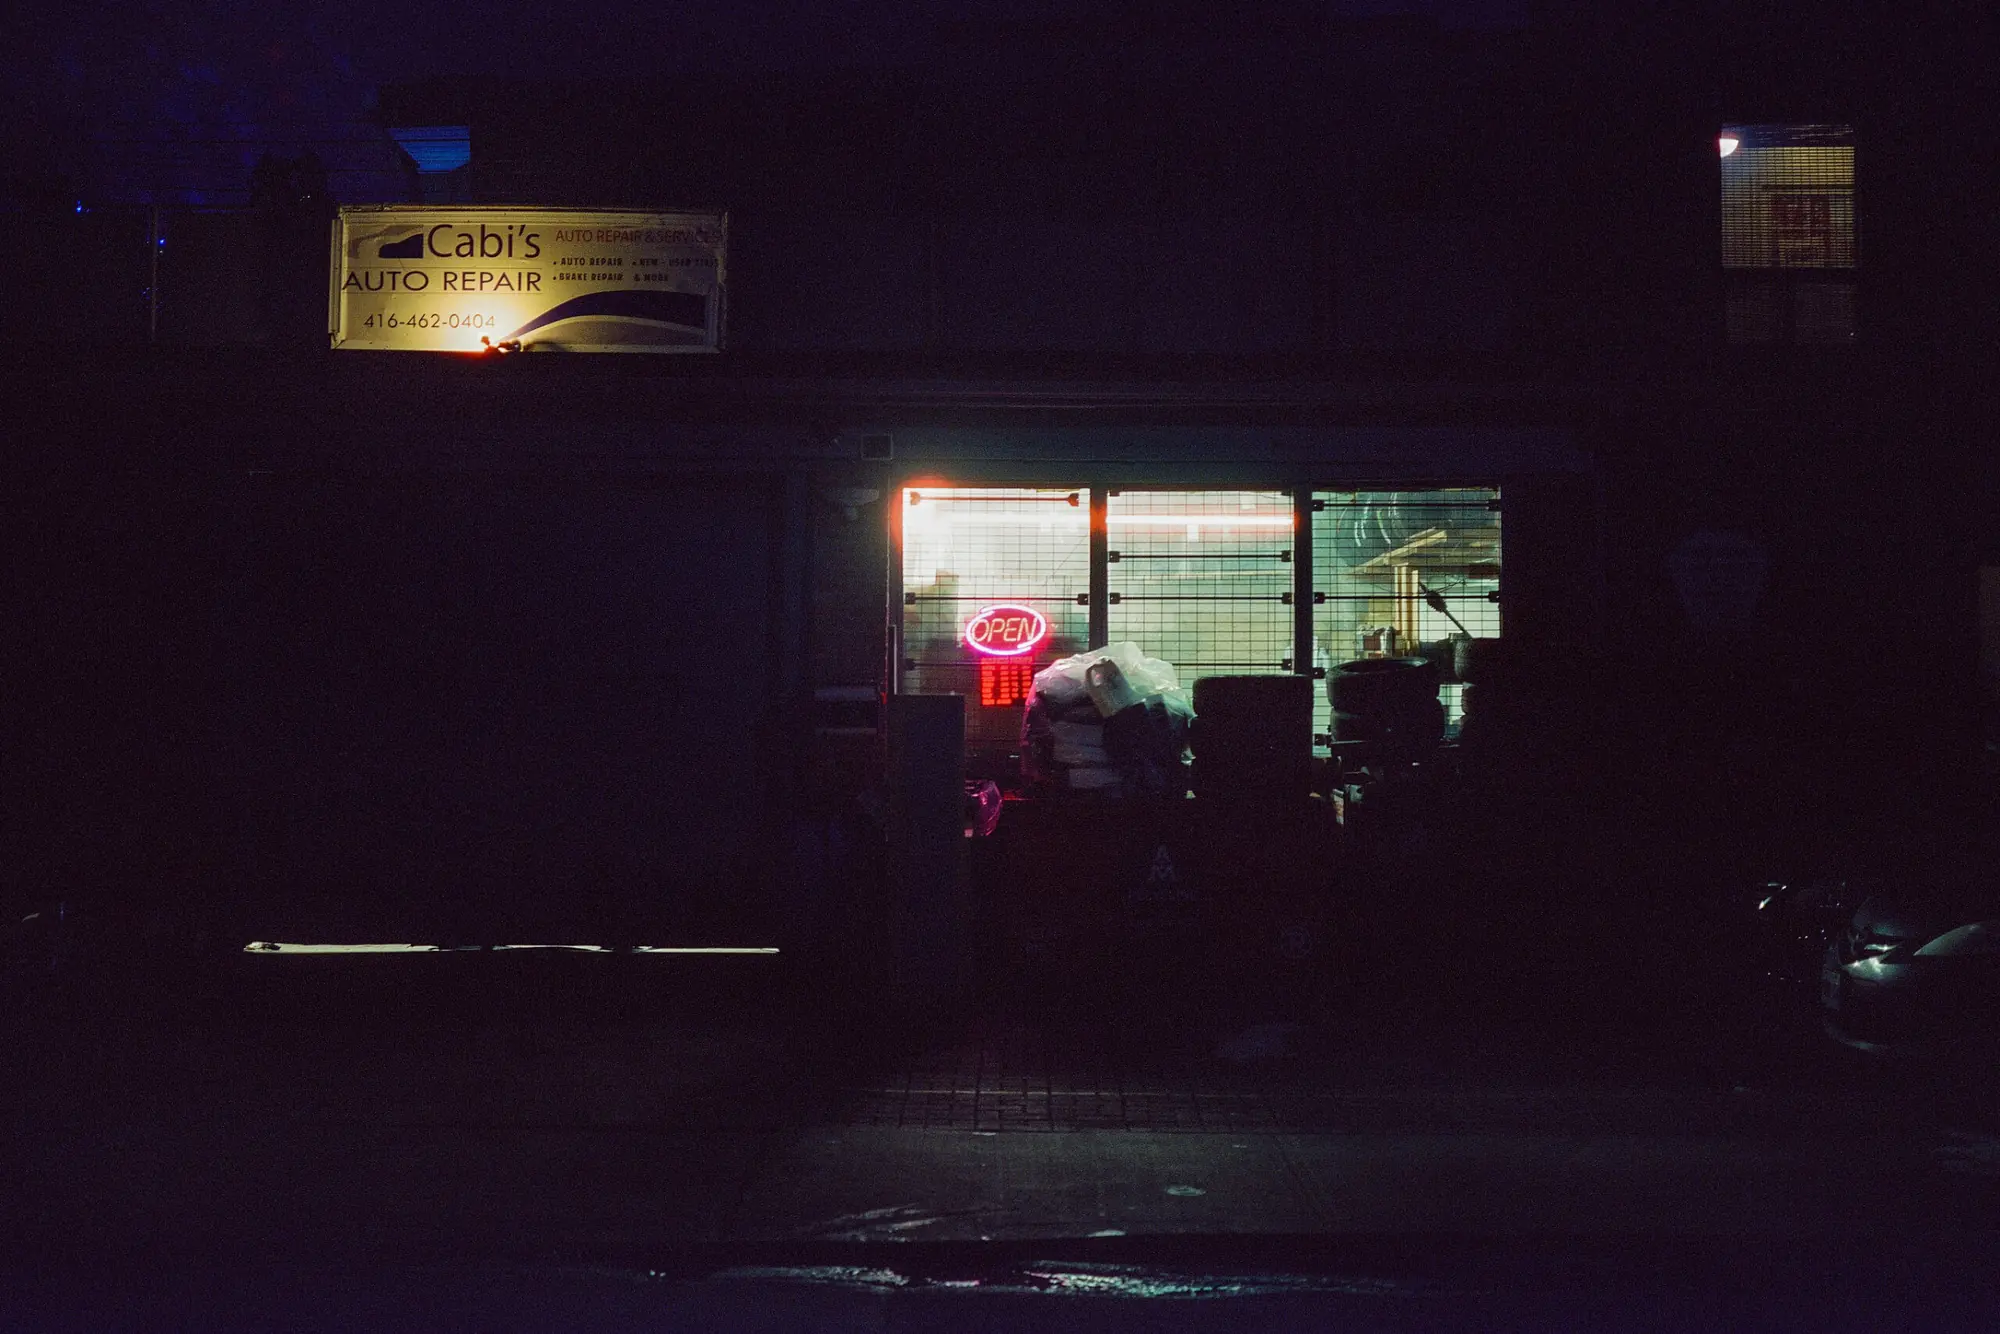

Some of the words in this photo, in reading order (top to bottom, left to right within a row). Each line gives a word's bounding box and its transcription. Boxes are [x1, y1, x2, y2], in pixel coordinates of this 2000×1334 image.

[427, 223, 541, 259] Cabi's
[555, 229, 593, 243] AUTO
[596, 229, 642, 244] REPAIR
[561, 257, 586, 266] AUTO
[589, 257, 623, 266] REPAIR
[342, 270, 429, 291] AUTO
[443, 271, 541, 292] REPAIR
[559, 273, 588, 281] BRAKE
[591, 273, 624, 281] REPAIR
[363, 313, 496, 329] 416-462-0404
[971, 616, 1037, 643] OPEN
